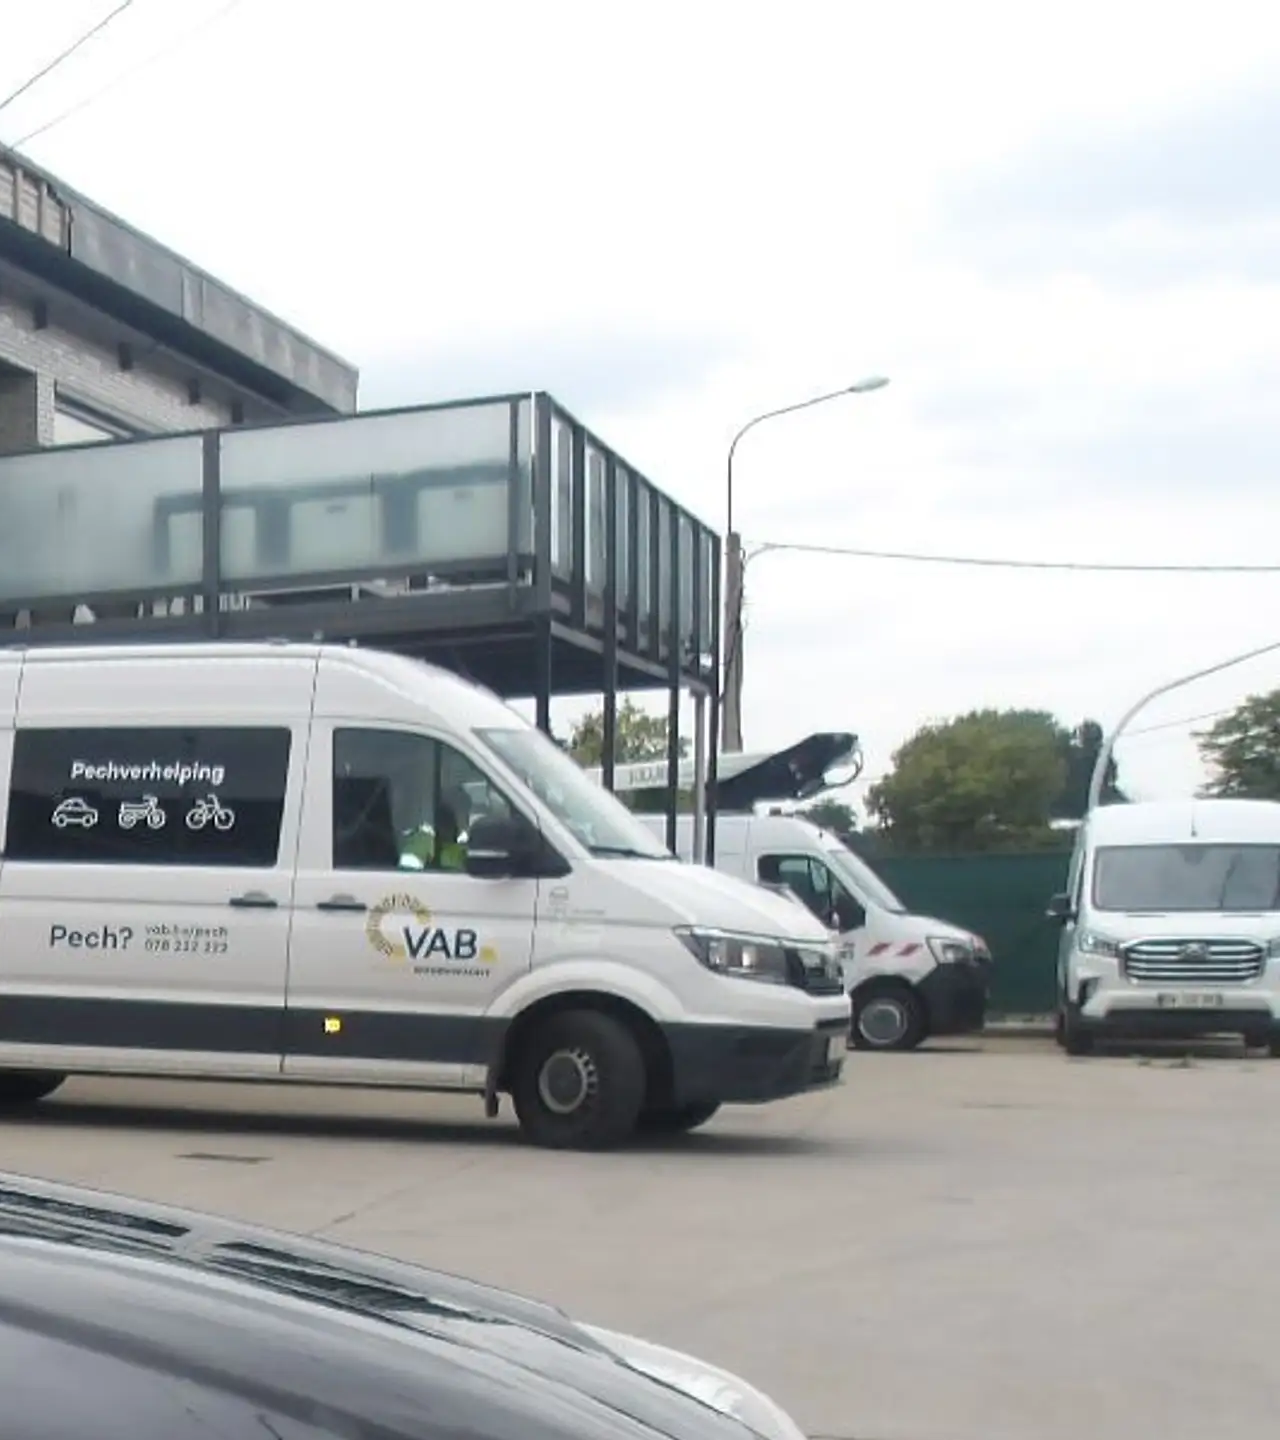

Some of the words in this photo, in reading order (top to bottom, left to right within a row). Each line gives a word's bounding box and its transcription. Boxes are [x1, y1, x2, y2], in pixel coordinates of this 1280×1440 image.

[71, 760, 225, 786] Pechverhelping
[49, 924, 133, 950] Pech?
[403, 926, 478, 959] VAB
